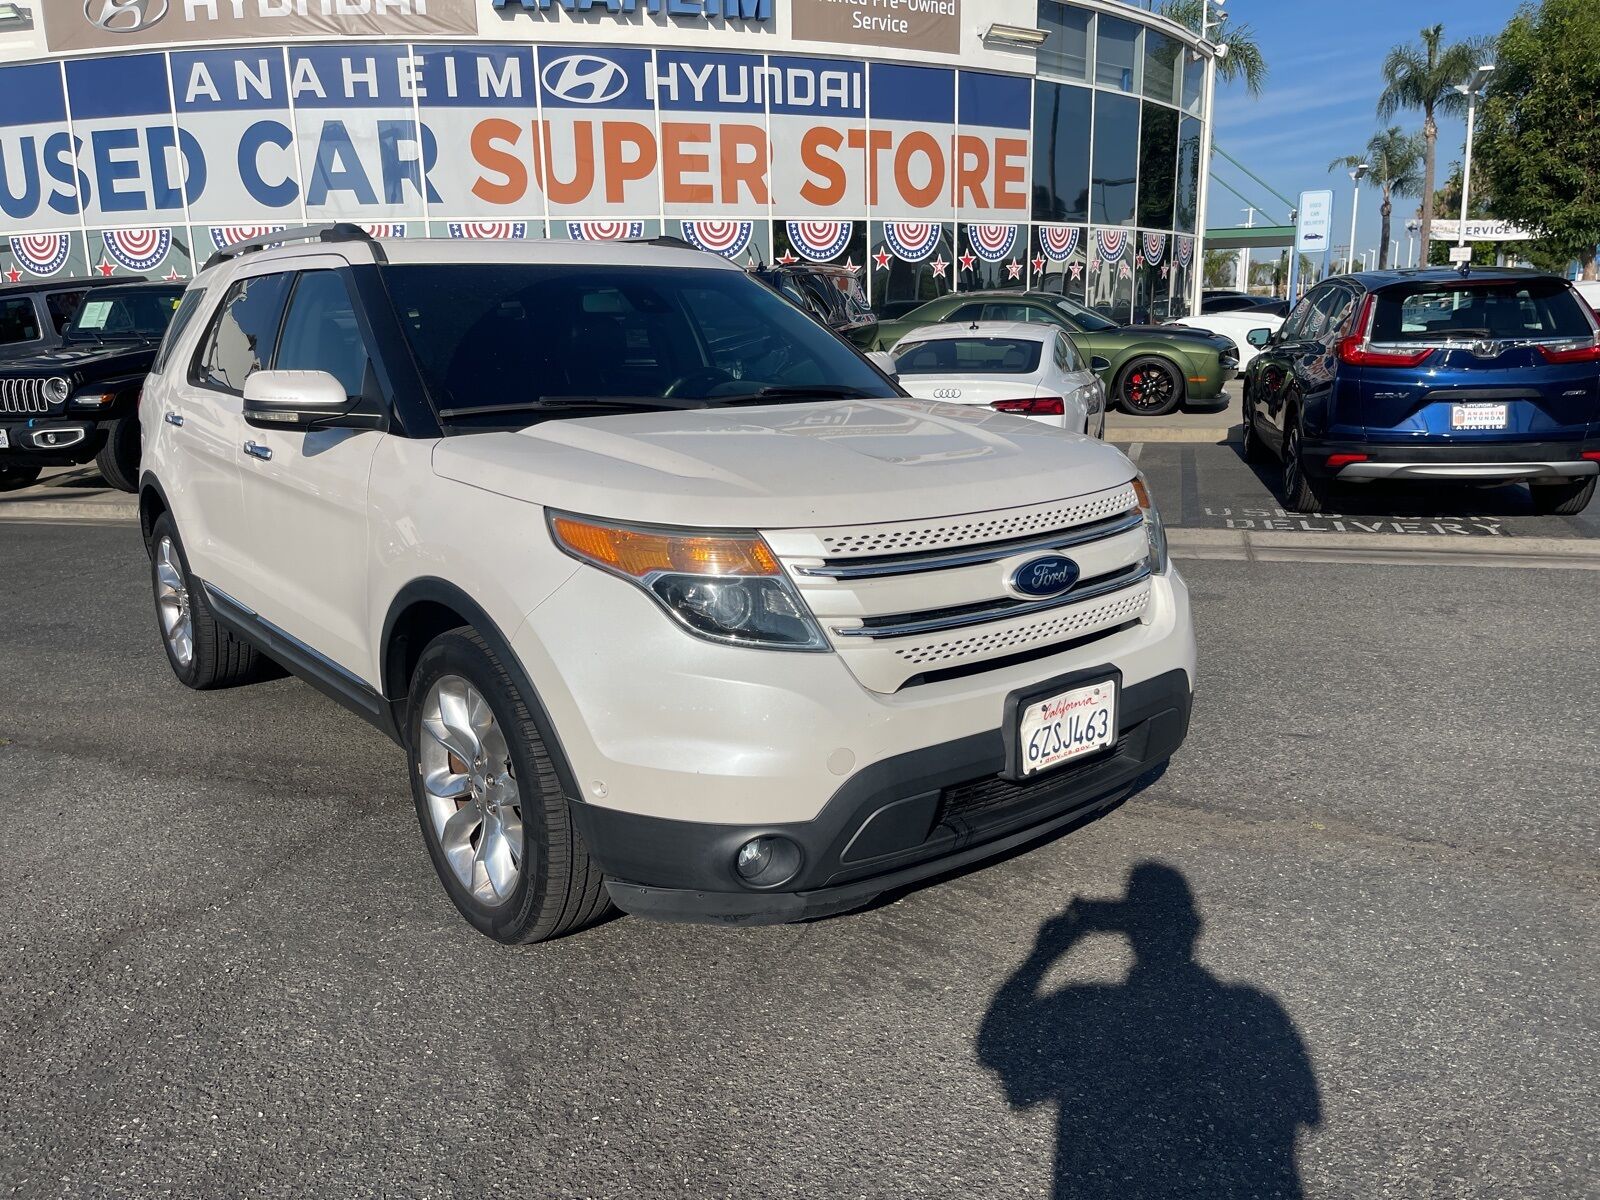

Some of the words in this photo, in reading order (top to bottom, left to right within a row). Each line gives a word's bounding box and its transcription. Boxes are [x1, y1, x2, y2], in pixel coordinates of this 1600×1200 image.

[852, 11, 908, 34] Service
[185, 57, 523, 103] ANAHEIM
[645, 61, 862, 109] HYUNDAI
[0, 126, 207, 219] USED
[237, 119, 444, 208] CAR
[470, 118, 776, 205] SUPER
[799, 126, 1028, 210] STORE
[1458, 225, 1510, 236] ERVICE
[1226, 519, 1501, 535] DELIVERY
[1031, 562, 1069, 589] Ford
[1043, 696, 1099, 721] California
[1028, 708, 1108, 761] 6ZSJ463
[1044, 745, 1090, 763] dmv.ca.gov
